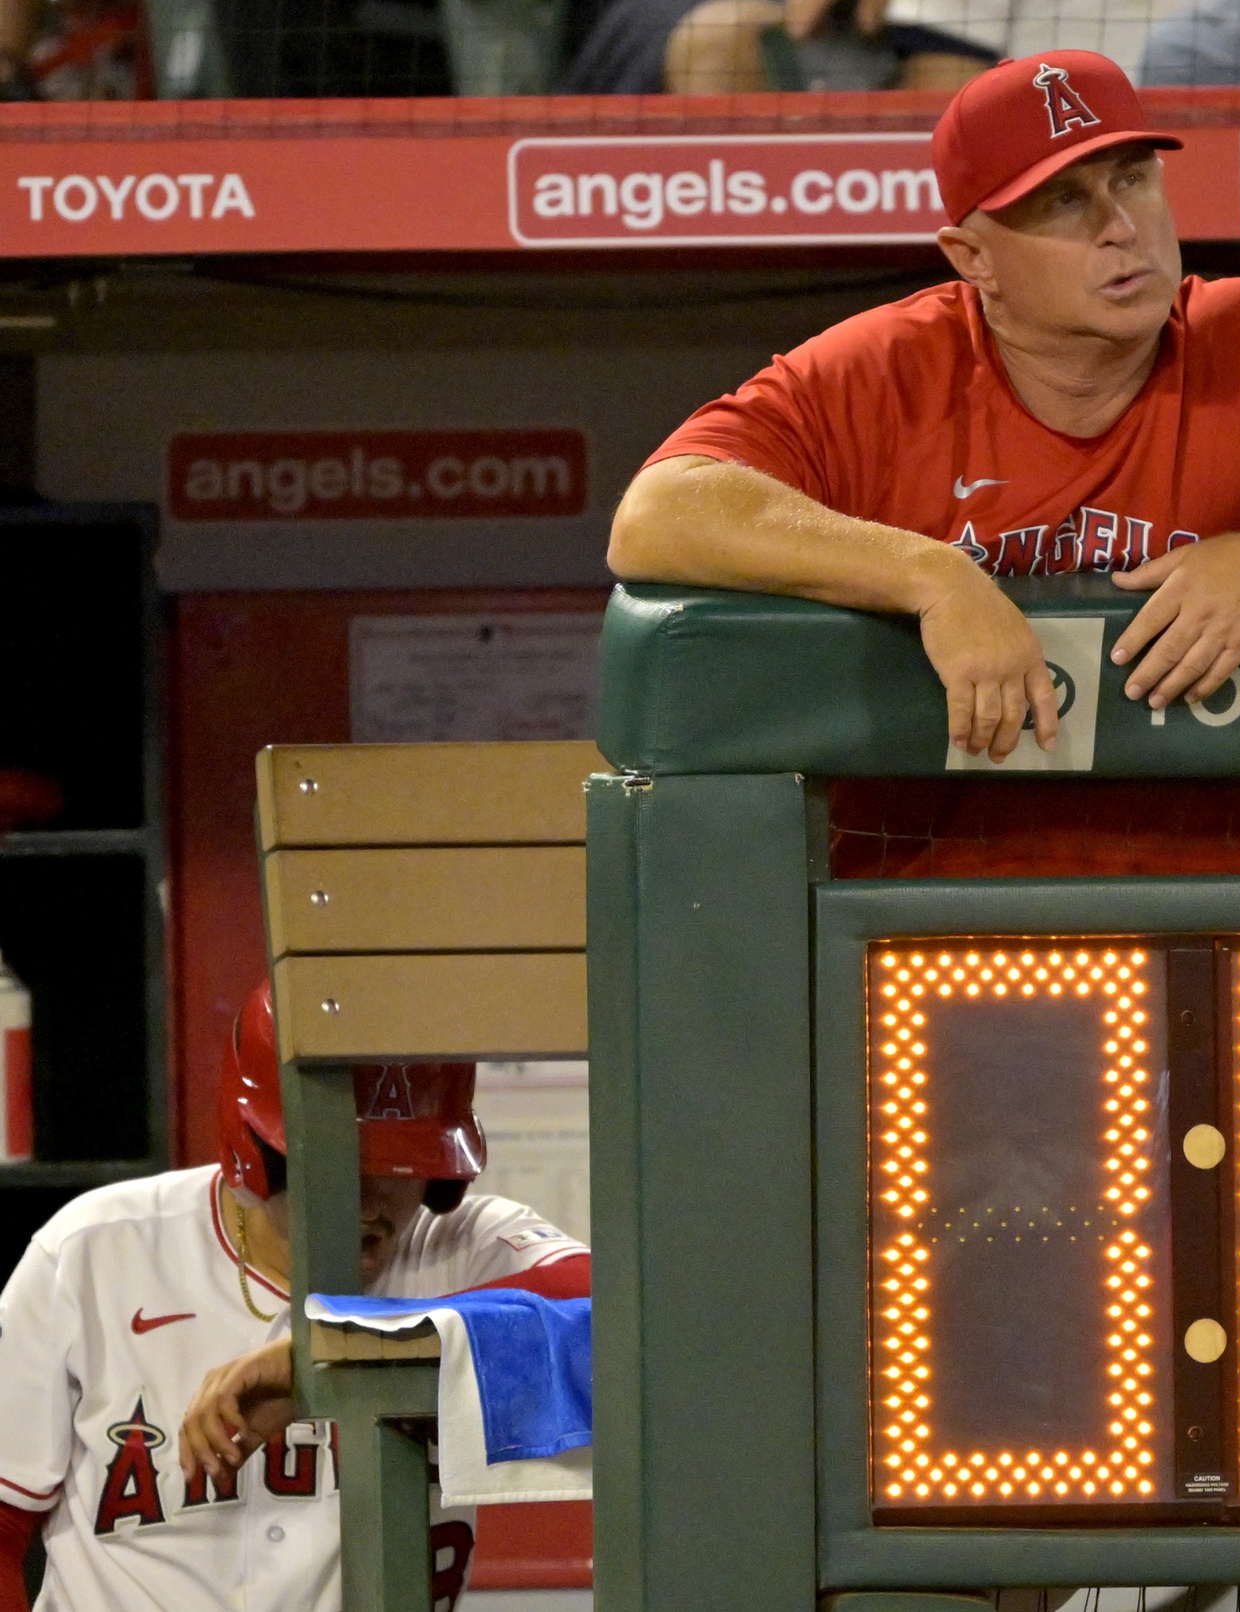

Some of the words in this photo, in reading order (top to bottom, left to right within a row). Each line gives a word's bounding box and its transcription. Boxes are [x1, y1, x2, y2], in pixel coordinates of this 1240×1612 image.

[1033, 63, 1101, 138] A
[18, 173, 256, 222] TOYOTA
[532, 159, 945, 230] angels.com
[184, 448, 571, 512] angels.com
